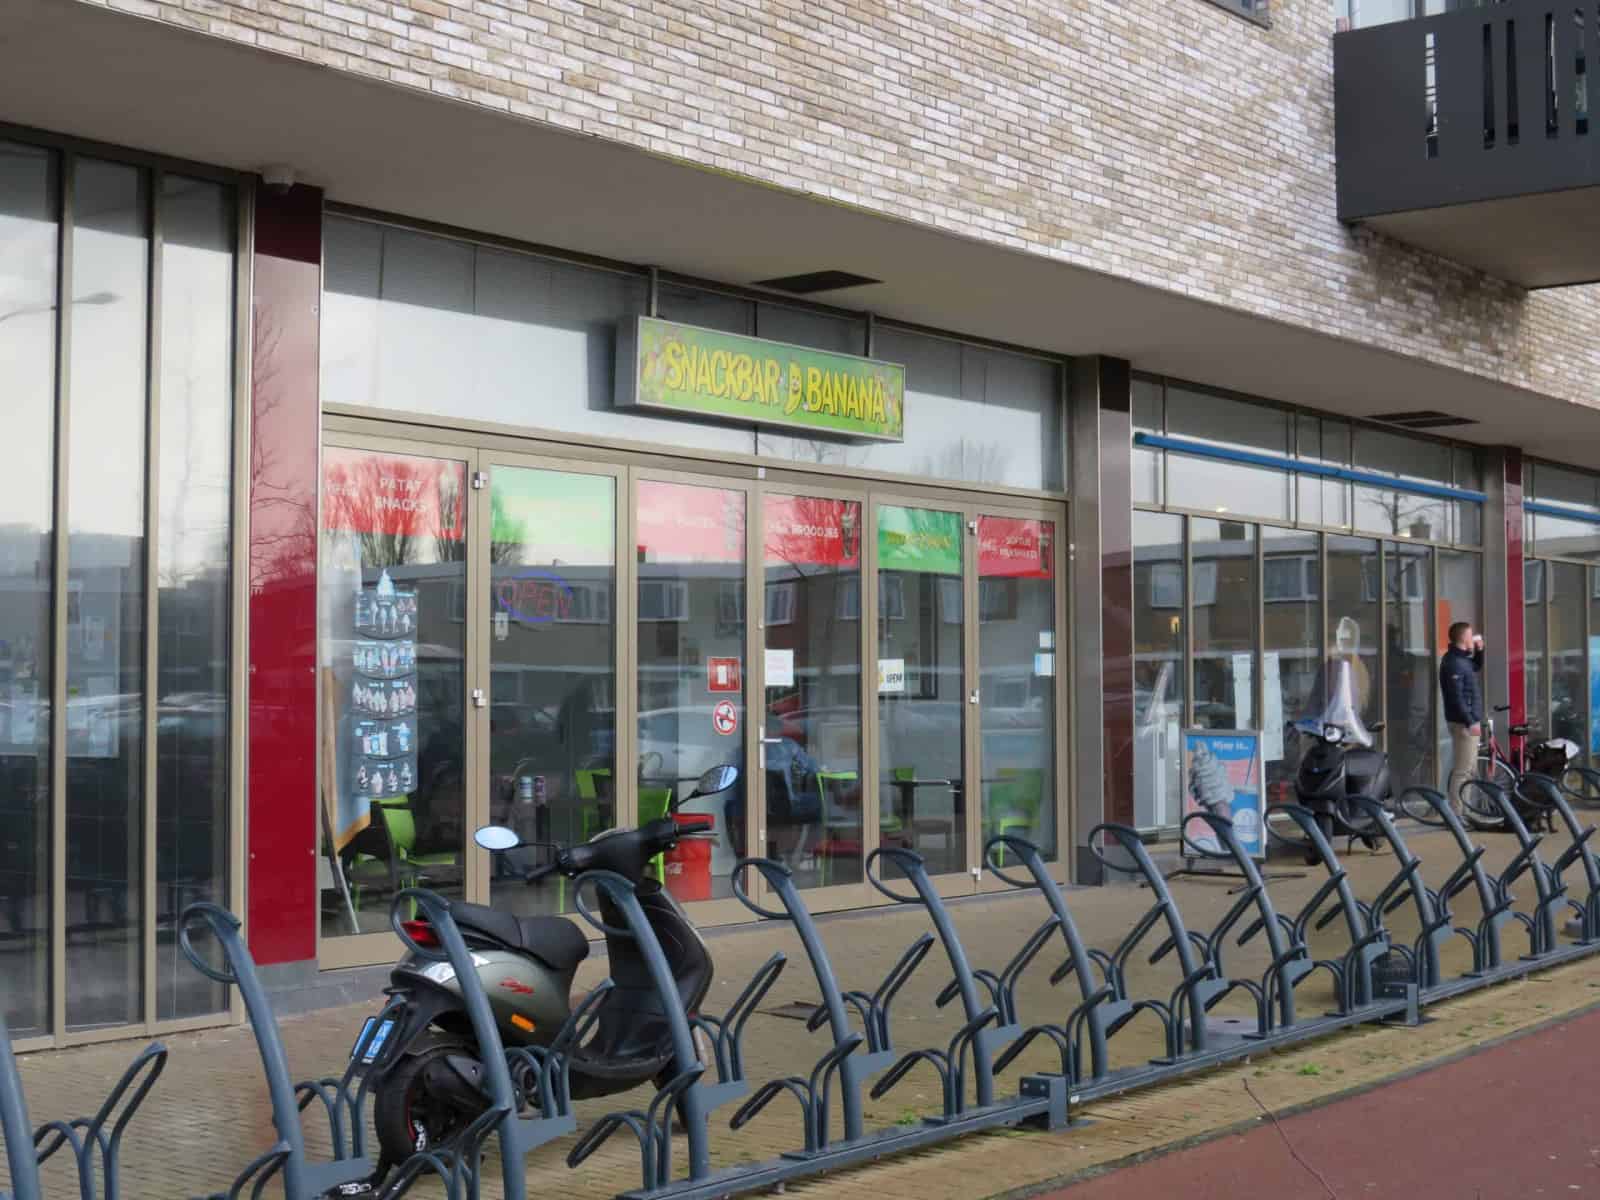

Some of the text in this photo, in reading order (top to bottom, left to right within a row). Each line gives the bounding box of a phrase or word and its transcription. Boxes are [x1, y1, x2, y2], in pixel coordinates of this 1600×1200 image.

[663, 340, 888, 424] SNACKBAR BANANA
[379, 478, 423, 491] PATAT
